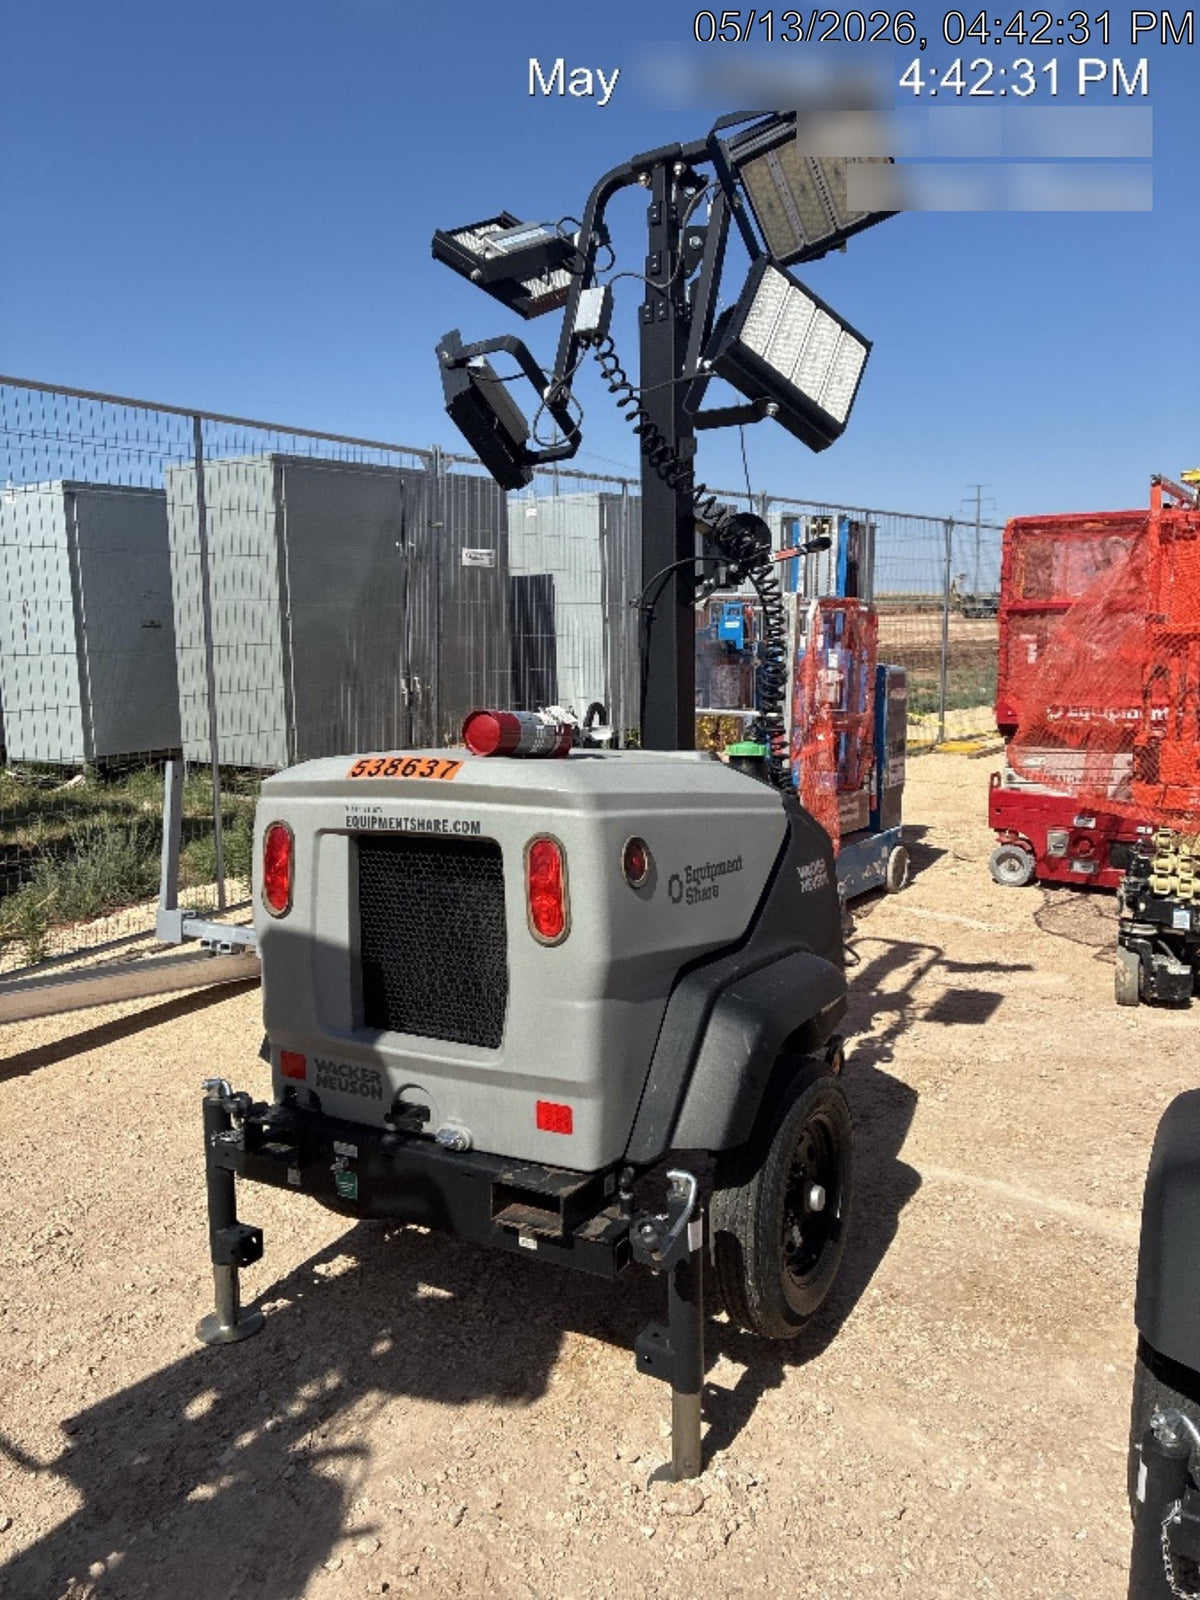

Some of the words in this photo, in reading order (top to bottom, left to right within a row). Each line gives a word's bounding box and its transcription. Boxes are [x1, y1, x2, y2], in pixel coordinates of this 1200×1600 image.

[352, 758, 459, 778] 538637
[345, 815, 481, 834] EQUIPMENTSHARE.COM
[685, 855, 744, 886] Equipment
[685, 885, 719, 905] Share
[313, 1058, 381, 1085] WACKER
[316, 1073, 383, 1101] NEUSON
